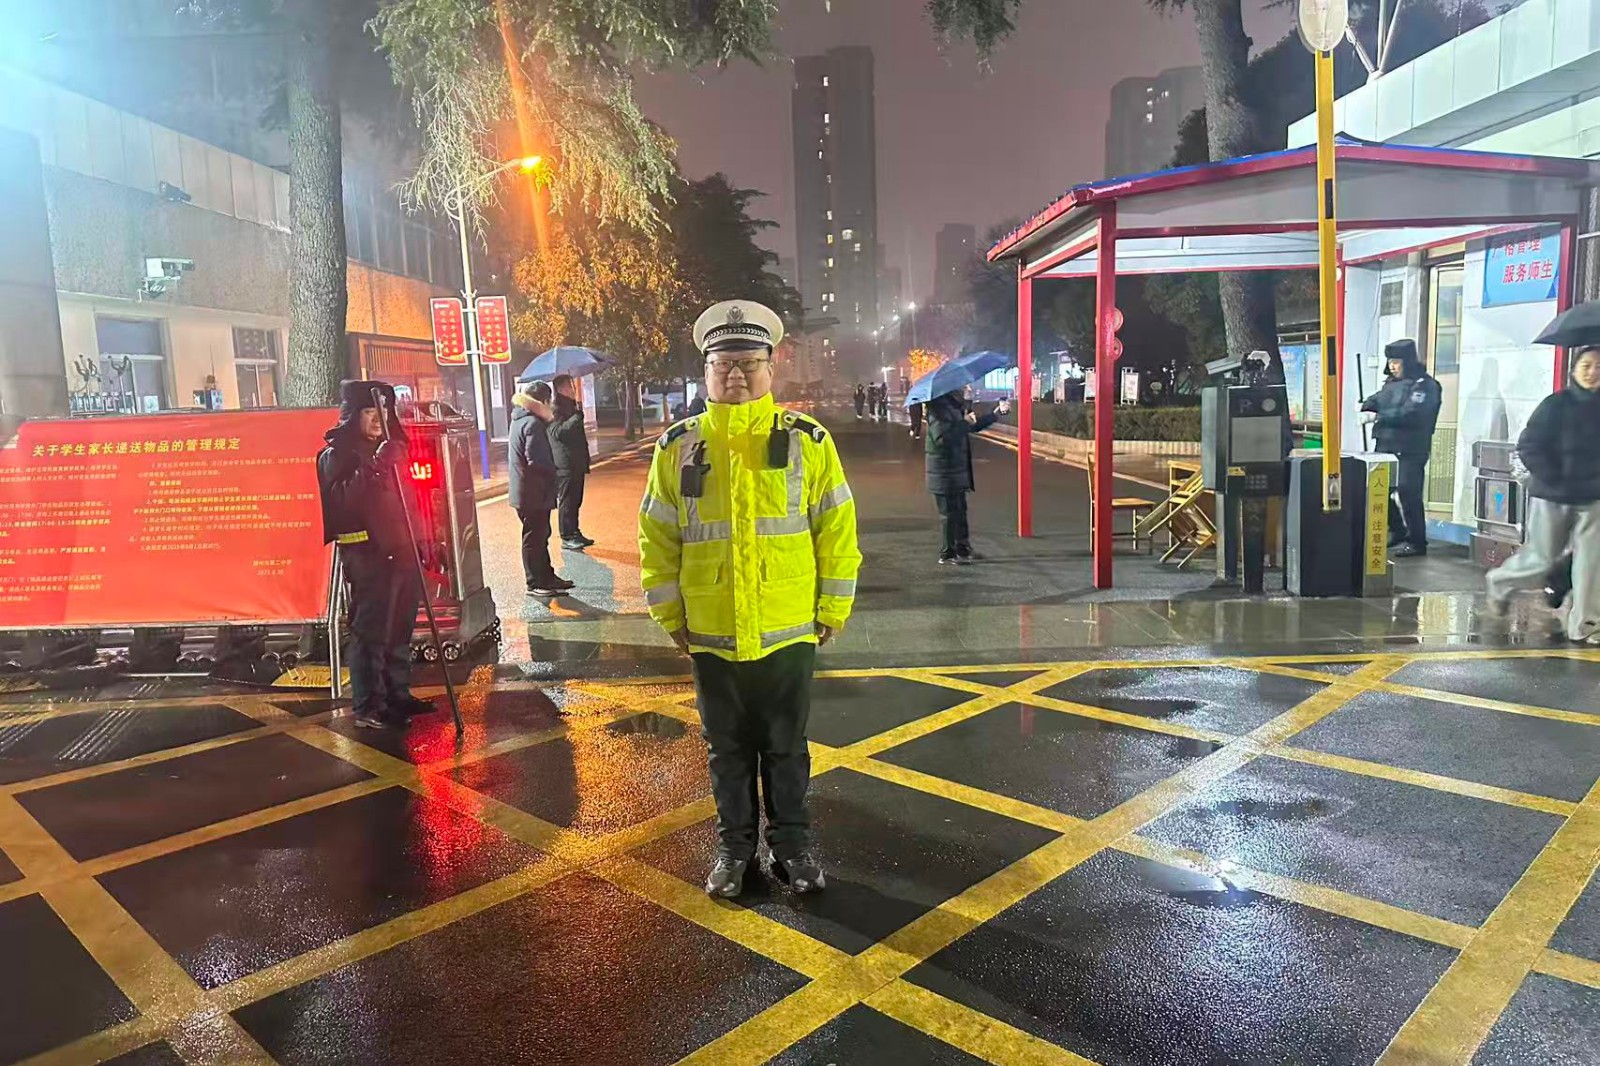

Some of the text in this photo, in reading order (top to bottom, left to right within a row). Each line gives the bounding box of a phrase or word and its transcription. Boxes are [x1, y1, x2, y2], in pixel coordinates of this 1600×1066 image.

[1502, 258, 1553, 283] 服务师生
[32, 437, 241, 457] 关于学生家长递送物品的管理规定
[1371, 467, 1385, 569] 一人一闸 注意安全
